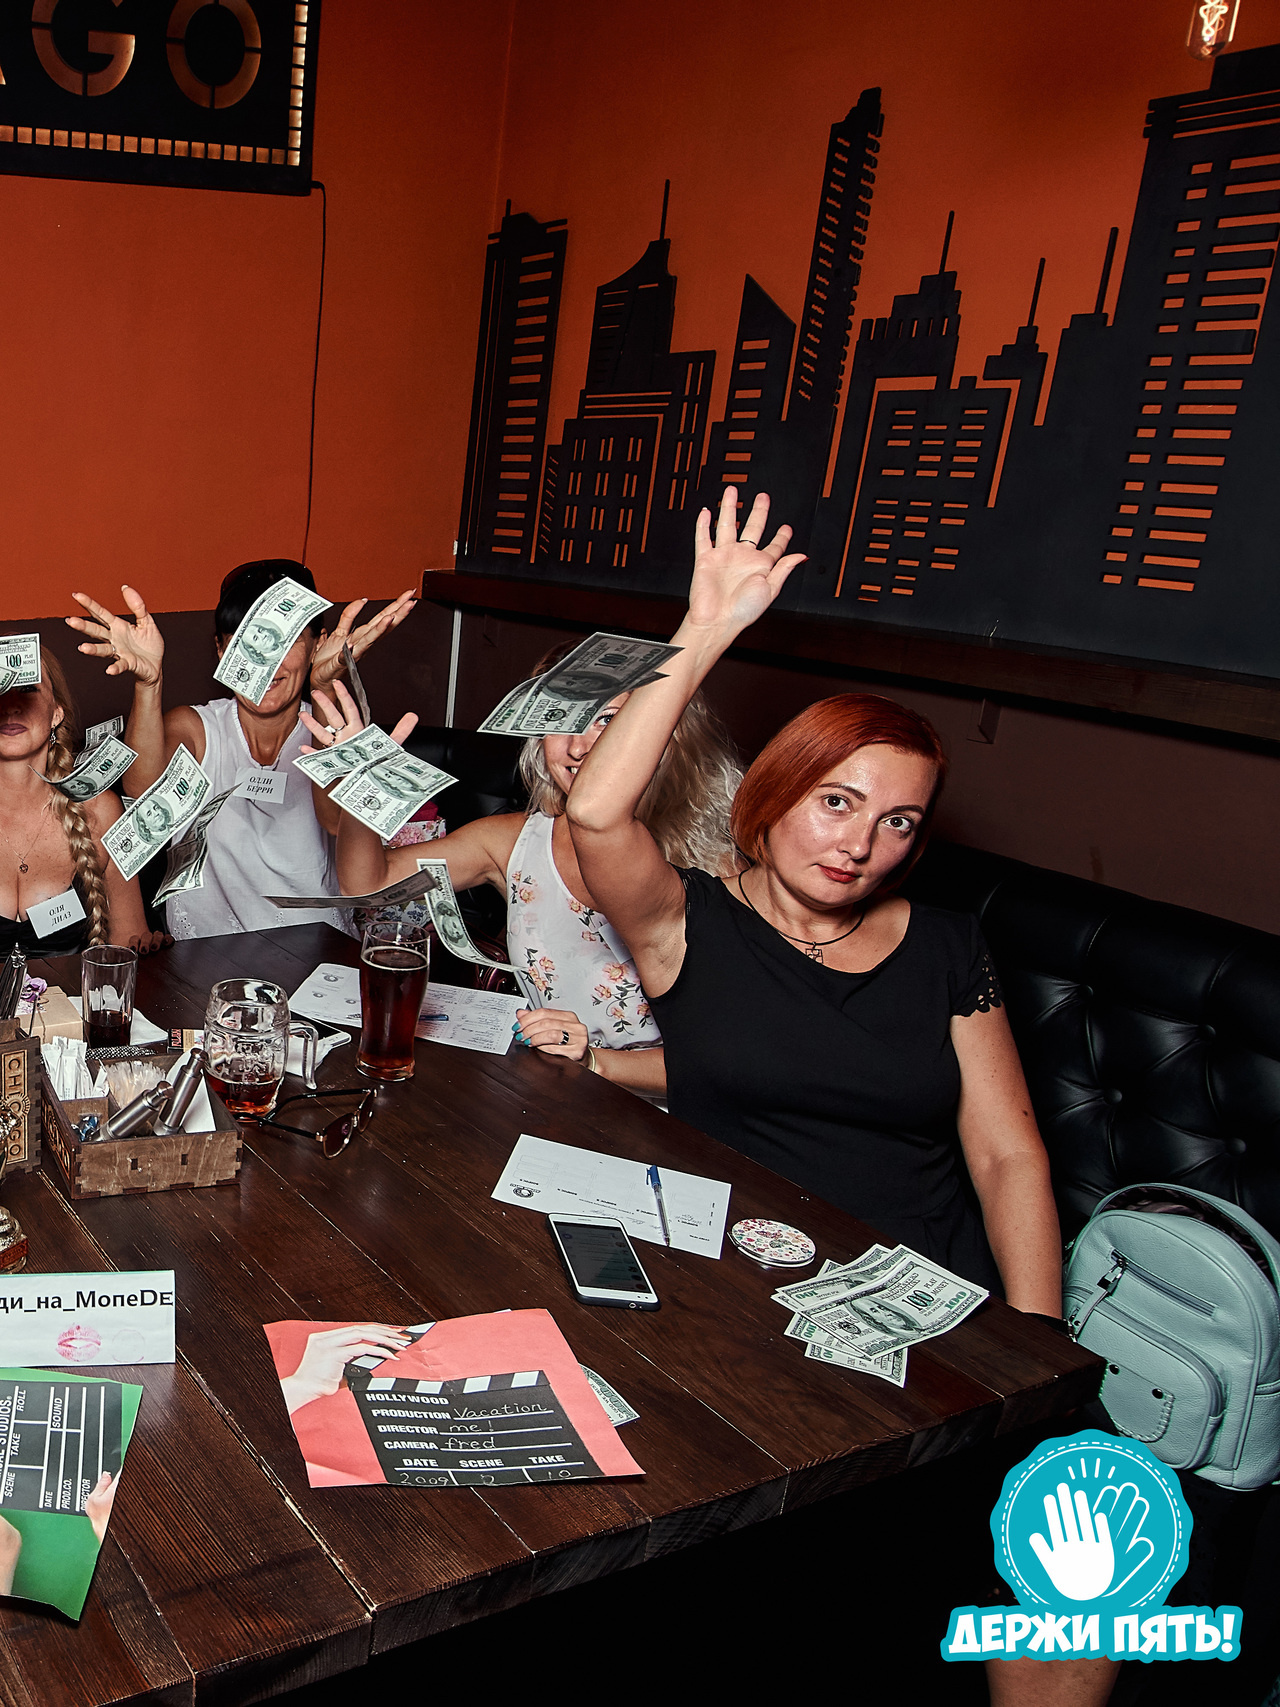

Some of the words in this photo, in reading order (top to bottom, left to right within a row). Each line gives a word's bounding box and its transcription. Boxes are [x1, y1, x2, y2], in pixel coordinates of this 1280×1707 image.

[274, 598, 296, 616] 100
[302, 600, 318, 612] 100
[5, 654, 22, 668] 100
[594, 654, 628, 668] 100
[96, 759, 113, 776] 100
[173, 777, 190, 800] 100
[193, 779, 204, 798] 100
[246, 785, 274, 794] БЕРРИ
[49, 904, 65, 916] ОЛЯ
[52, 911, 72, 926] ДИАЗ
[8, 1059, 22, 1155] CHICGO
[924, 1278, 937, 1289] PLAY
[931, 1280, 949, 1295] MONEY
[902, 1290, 934, 1311] 100
[944, 1291, 967, 1310] 100
[16, 1390, 26, 1411] ROLL
[366, 1393, 449, 1405] HOLLYWOOD
[52, 1397, 62, 1428] SOUND
[372, 1409, 451, 1420] PRODUCTION
[454, 1403, 548, 1419] Vacation
[377, 1424, 439, 1435] DIRECTOR
[10, 1433, 21, 1456] TAKE
[384, 1441, 439, 1451] CAMERA
[444, 1437, 496, 1450] fred
[403, 1458, 438, 1467] DATE
[459, 1458, 504, 1468] SCENE
[528, 1455, 566, 1464] TAKE
[5, 1472, 16, 1497] SCENE
[400, 1473, 448, 1485] 2009
[44, 1491, 53, 1507] DATE
